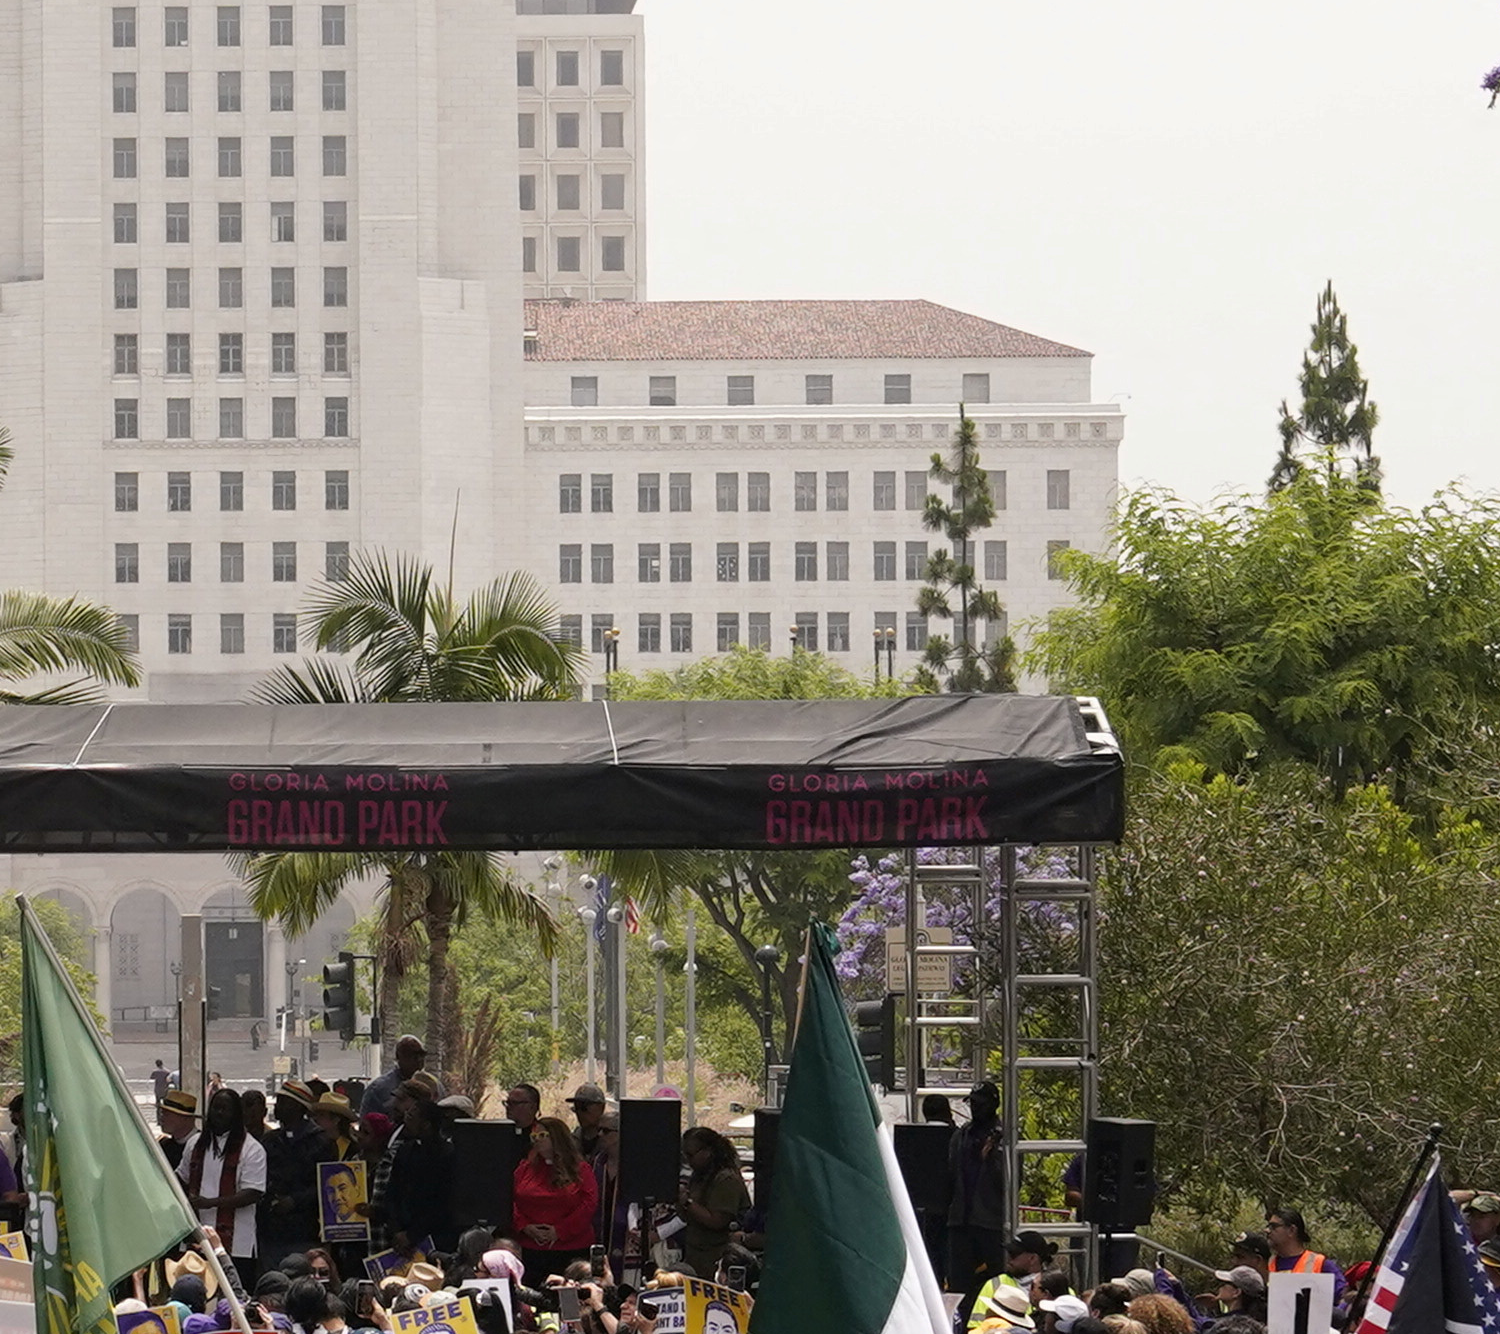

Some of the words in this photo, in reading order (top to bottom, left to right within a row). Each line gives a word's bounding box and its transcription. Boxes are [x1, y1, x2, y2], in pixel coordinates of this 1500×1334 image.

[229, 773, 329, 791] GLORIA
[346, 773, 448, 791] MOLINA
[768, 773, 868, 792] GLORIA
[885, 770, 988, 790] MOLINA
[228, 800, 344, 845] GRAND
[359, 801, 448, 845] PARK
[765, 800, 883, 844] GRAND
[896, 796, 988, 840] PARK
[690, 1280, 740, 1307] FREE
[398, 1301, 462, 1330] FREE
